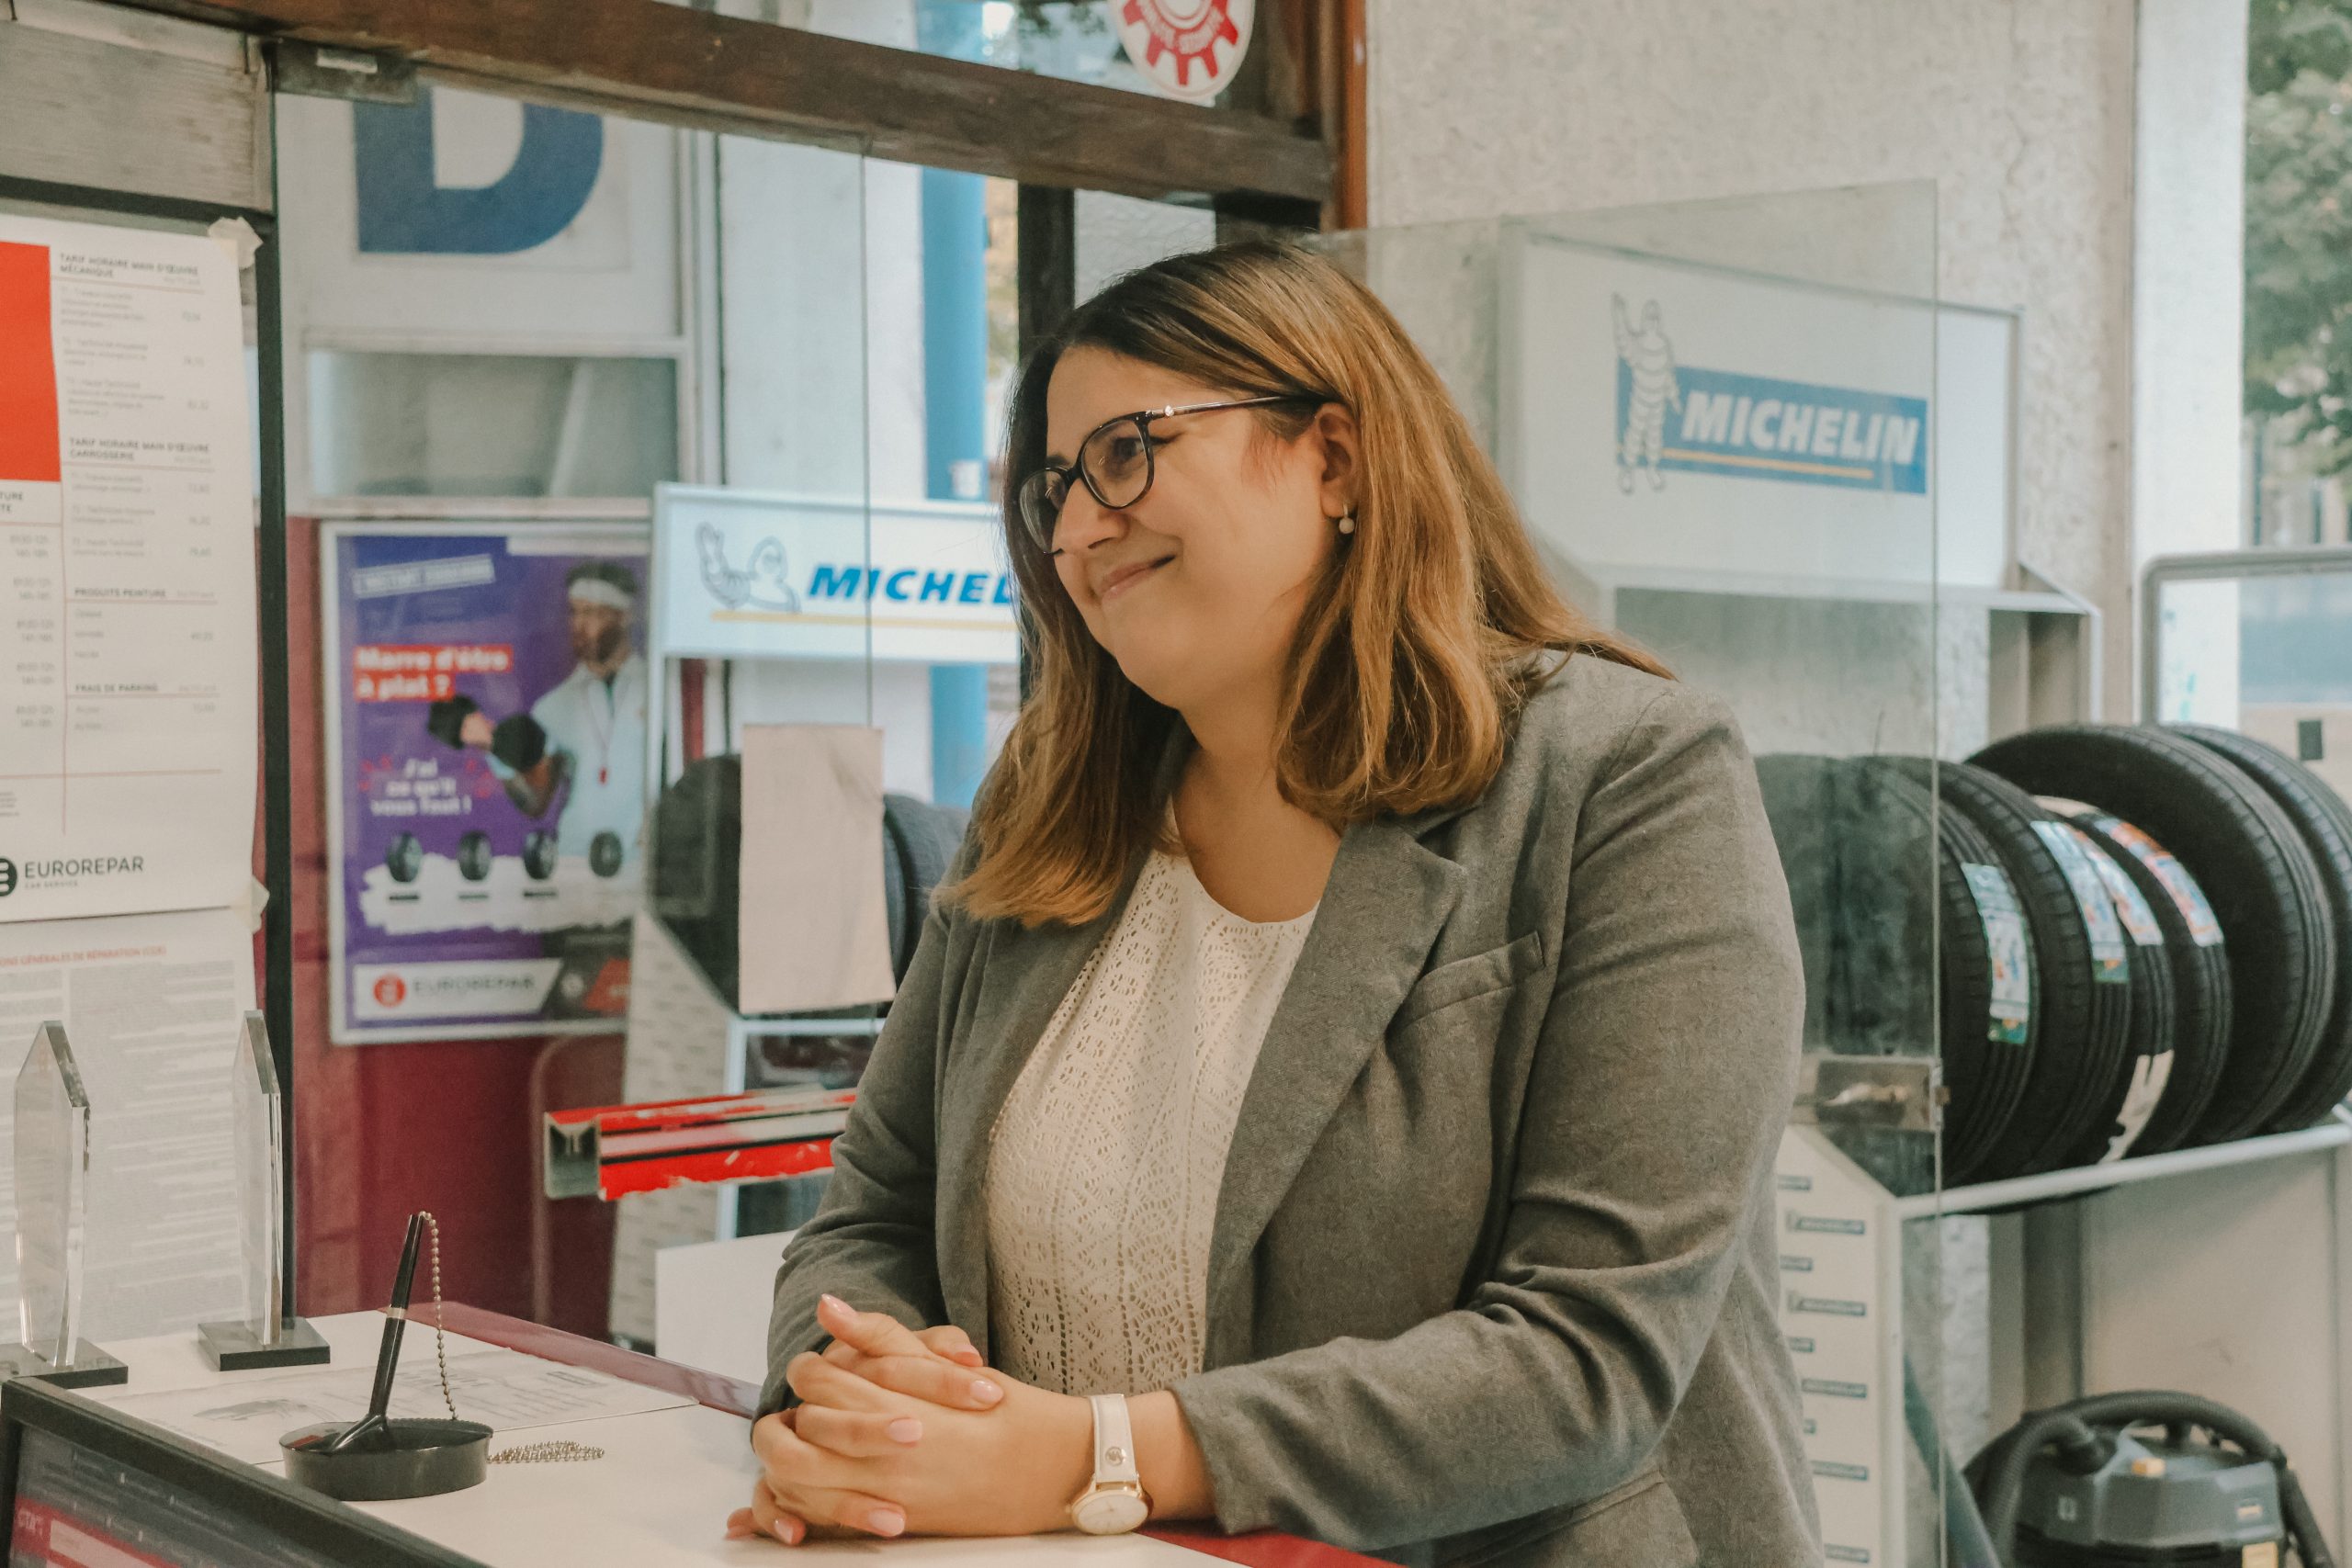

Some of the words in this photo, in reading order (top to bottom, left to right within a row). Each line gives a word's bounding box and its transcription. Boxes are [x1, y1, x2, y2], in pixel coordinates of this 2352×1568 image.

[1680, 390, 1920, 466] MICHELIN
[70, 438, 96, 448] TARIF
[74, 588, 120, 597] PRODUITS
[122, 589, 166, 598] PEINTURE
[357, 649, 431, 671] Marre
[75, 684, 101, 693] FRAIS
[435, 673, 450, 697] ?
[370, 799, 417, 817] vous
[25, 856, 144, 879] EUROREPAR
